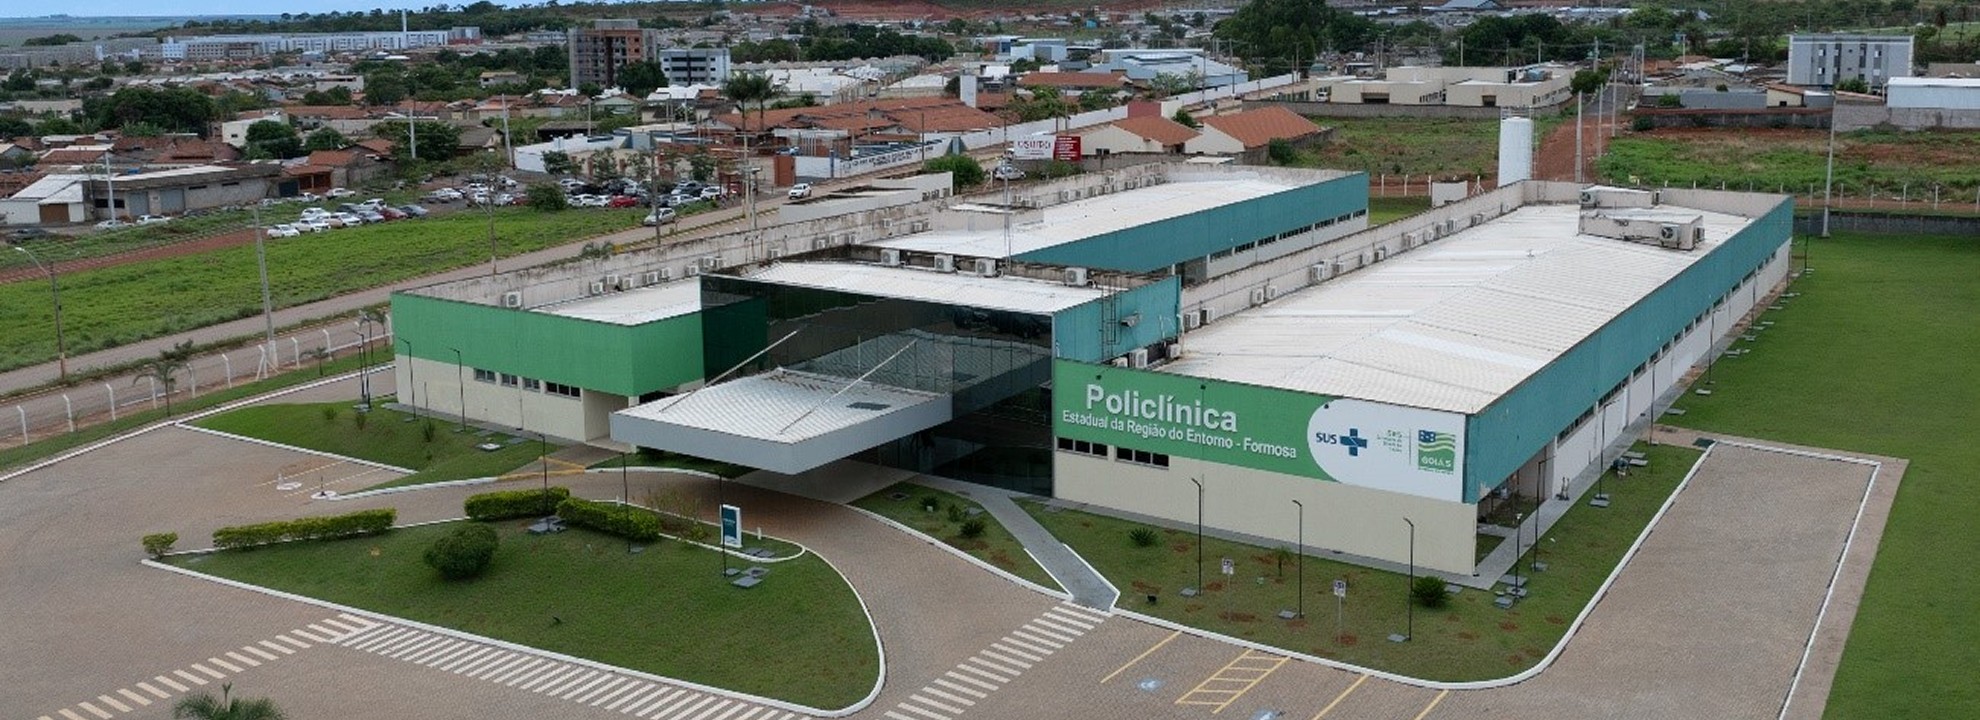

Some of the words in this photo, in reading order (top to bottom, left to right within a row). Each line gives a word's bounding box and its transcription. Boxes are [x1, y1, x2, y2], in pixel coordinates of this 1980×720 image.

[1086, 384, 1238, 433] Policlínica
[1062, 409, 1109, 429] Estadual
[1110, 418, 1124, 431] da
[1127, 420, 1167, 439] Região
[1168, 427, 1184, 440] do
[1186, 428, 1234, 449] Entorno
[1243, 437, 1297, 459] Formosa
[1316, 432, 1337, 445] SUS
